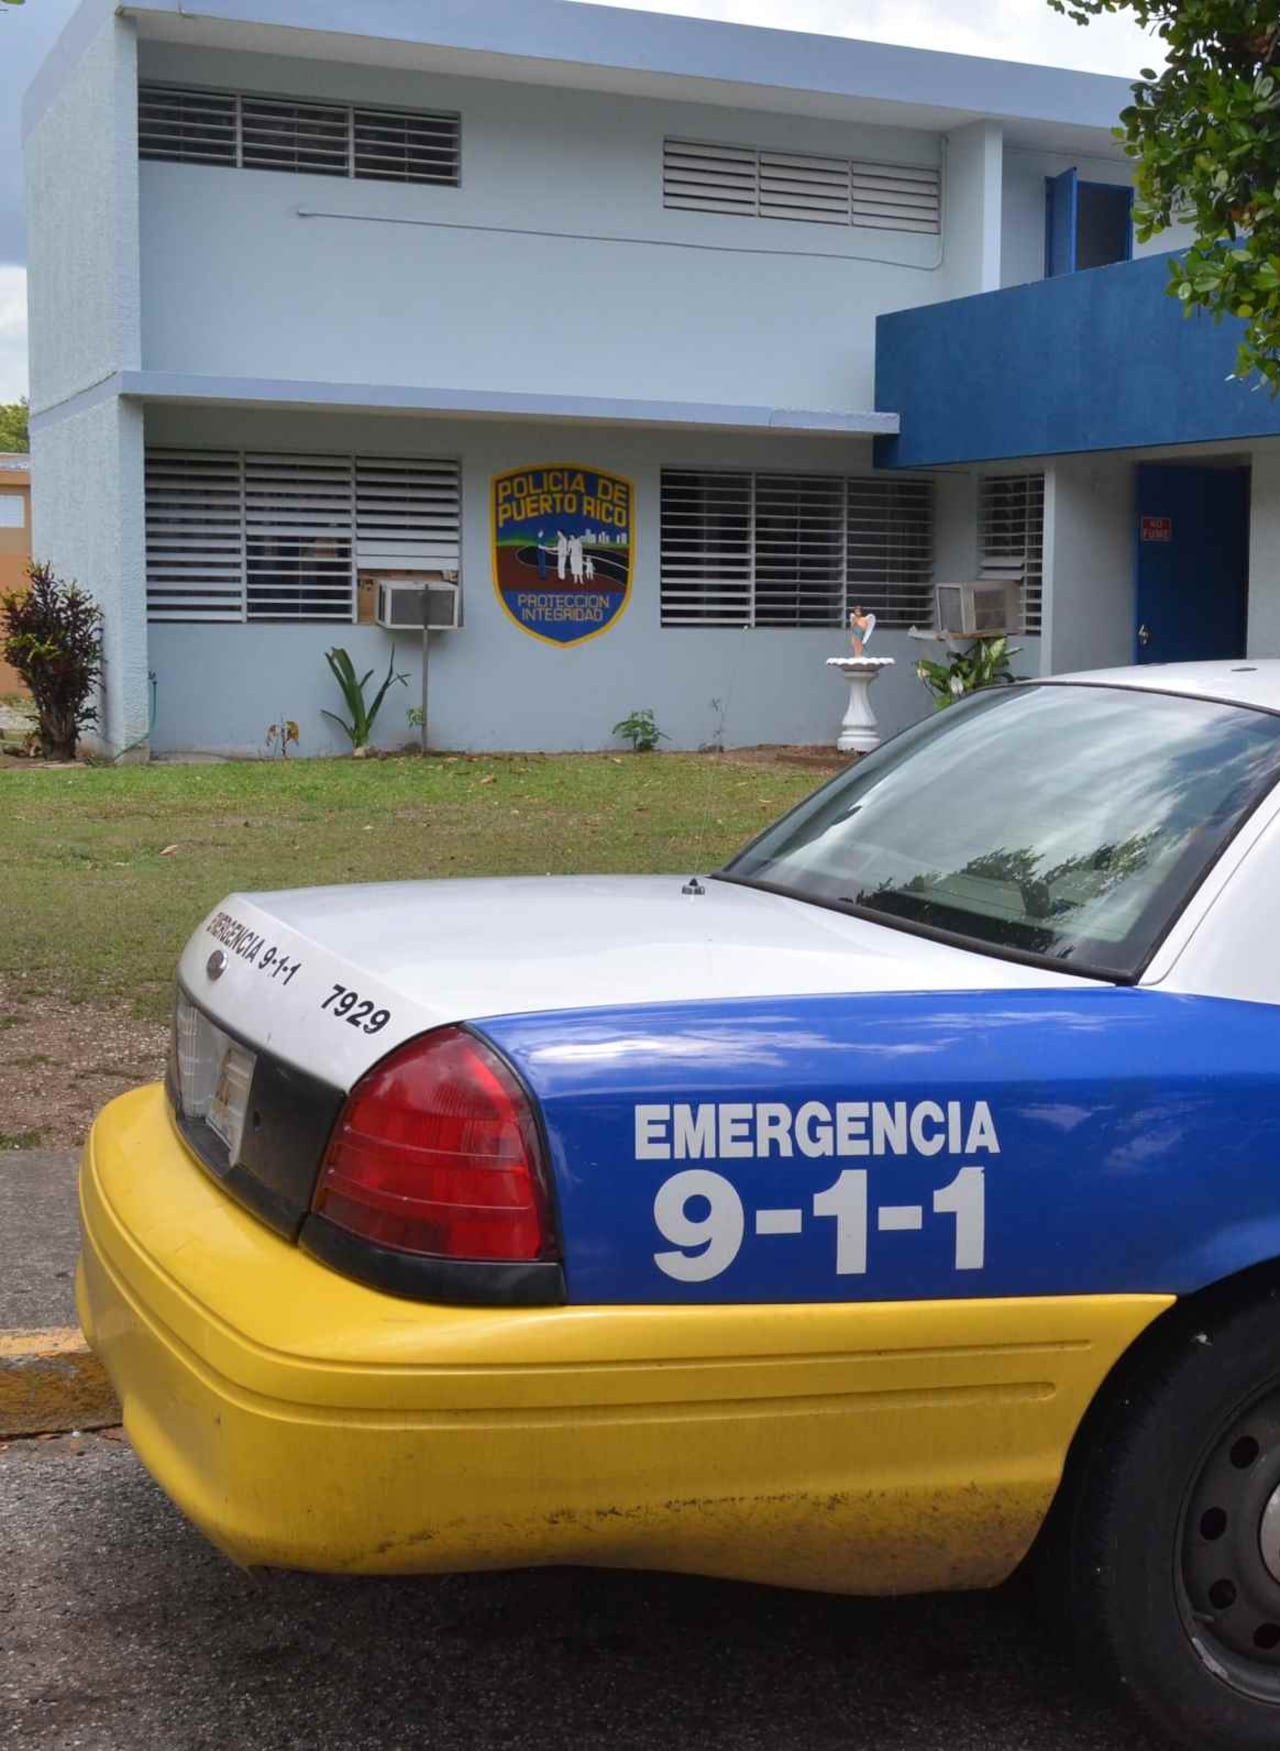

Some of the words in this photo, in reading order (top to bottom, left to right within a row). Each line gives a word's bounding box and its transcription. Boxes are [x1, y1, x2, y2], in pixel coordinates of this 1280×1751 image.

[498, 471, 586, 503] POLICIA
[597, 478, 627, 507] DE
[498, 493, 577, 528] PUERTO
[583, 496, 627, 527] RICO
[518, 594, 611, 609] PROTECCION
[522, 608, 603, 622] INTEGRIDAD
[320, 984, 391, 1035] 7929
[634, 1100, 1001, 1160] EMERGENCIA
[653, 1166, 985, 1283] 9-1-1
